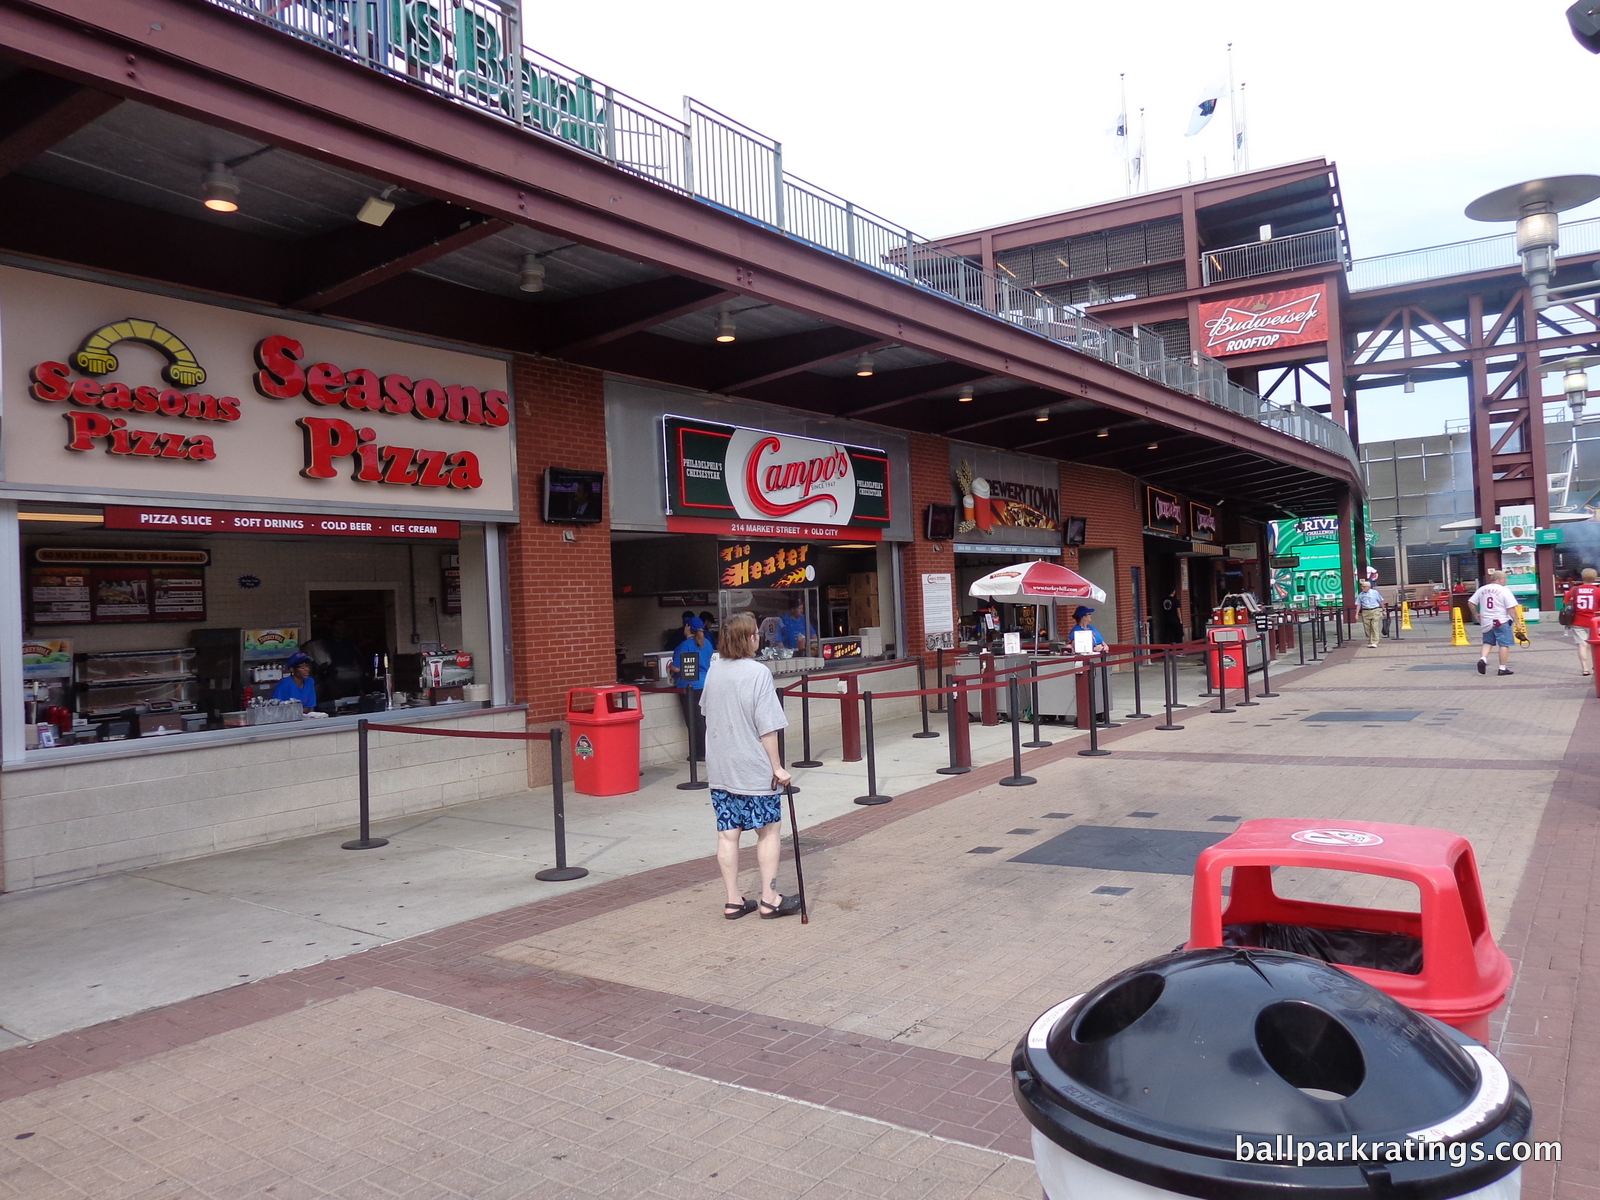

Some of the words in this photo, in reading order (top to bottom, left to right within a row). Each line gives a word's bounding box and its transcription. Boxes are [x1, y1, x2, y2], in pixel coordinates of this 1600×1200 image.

[1204, 309, 1317, 337] Budweiser
[1226, 334, 1280, 352] ROOFTOP
[28, 360, 242, 422] Seasons
[253, 335, 510, 427] Seasons
[62, 411, 217, 461] Pizza
[295, 416, 484, 489] Pizza
[745, 436, 848, 517] Campo's
[984, 478, 1060, 522] REWERYTOWN
[140, 513, 178, 525] PIZZA
[180, 515, 212, 526] SLICE
[234, 517, 261, 527] SOFT
[264, 518, 304, 529] DRINKS
[321, 520, 347, 531] COLD
[350, 521, 372, 532] BEER
[391, 524, 405, 533] ICE
[408, 525, 437, 534] CREAM
[731, 523, 745, 532] 214
[746, 524, 774, 533] MARKET
[776, 525, 800, 534] STREET
[811, 528, 824, 536] OLD
[825, 528, 838, 536] CITY
[1502, 515, 1520, 527] GIVE
[1522, 514, 1528, 526] A
[1502, 525, 1534, 539] GLVE
[720, 544, 751, 562] The
[721, 543, 809, 587] Heater
[1486, 596, 1494, 609] 6
[1576, 595, 1594, 610] 51
[1061, 1084, 1104, 1108] RECYCLE
